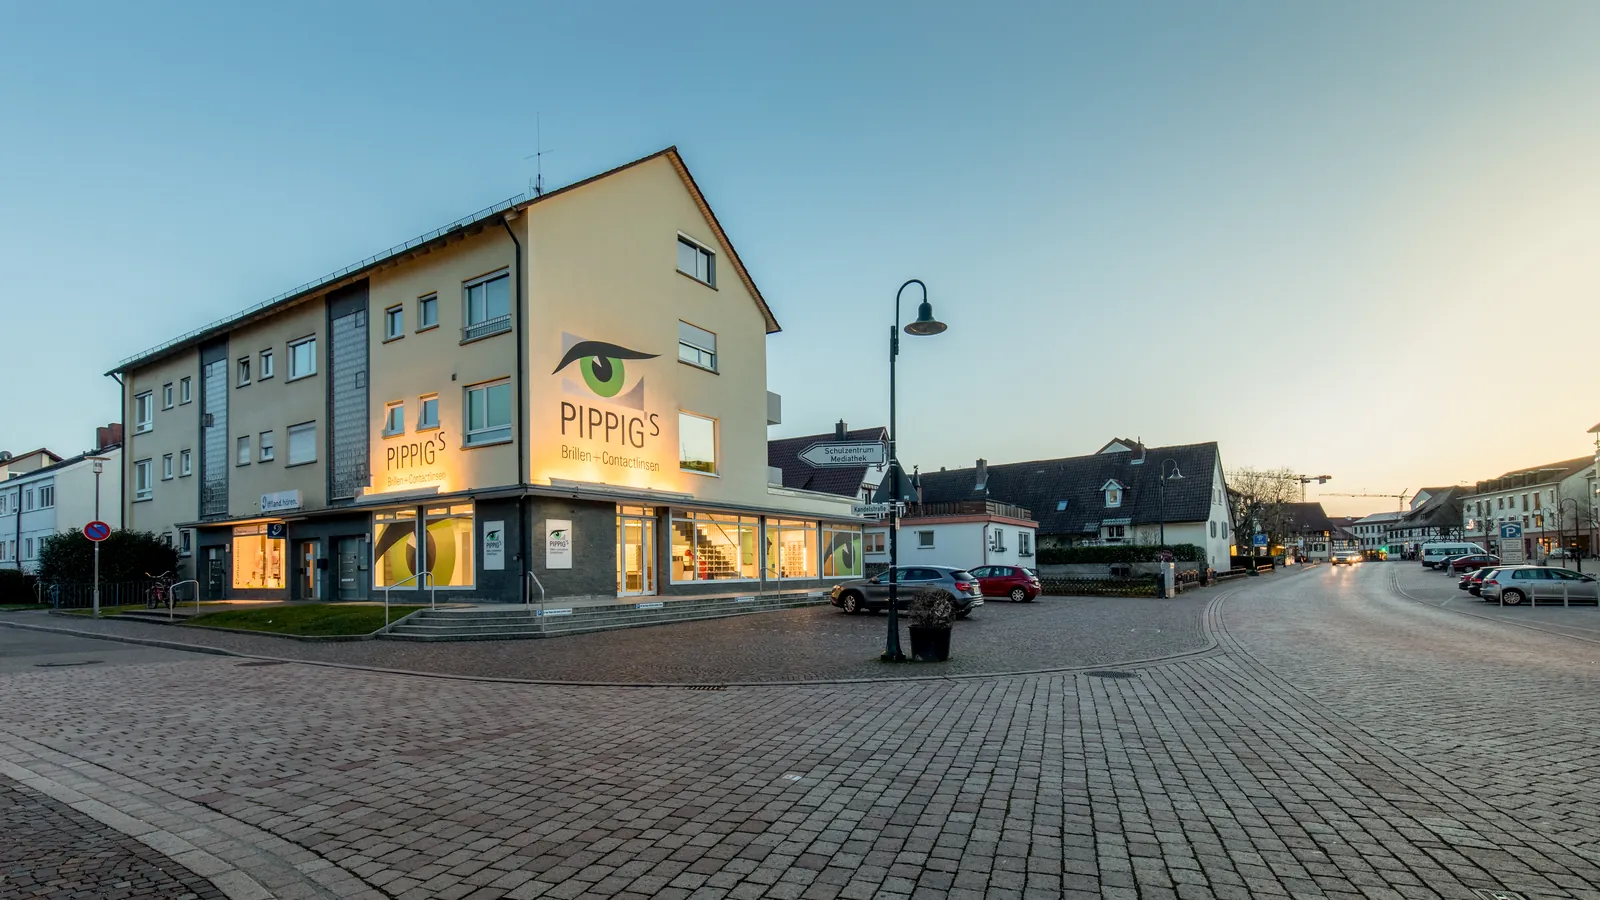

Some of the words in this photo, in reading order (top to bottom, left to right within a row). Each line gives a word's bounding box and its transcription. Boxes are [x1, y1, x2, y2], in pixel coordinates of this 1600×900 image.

[561, 401, 660, 449] PIPPIG'S
[387, 431, 446, 471] PIPPIG'S
[561, 444, 592, 462] Brillen
[602, 450, 660, 472] Contactlinsen
[824, 447, 875, 455] Schulzentrum
[830, 455, 868, 463] Mediathek
[1506, 526, 1516, 538] P
